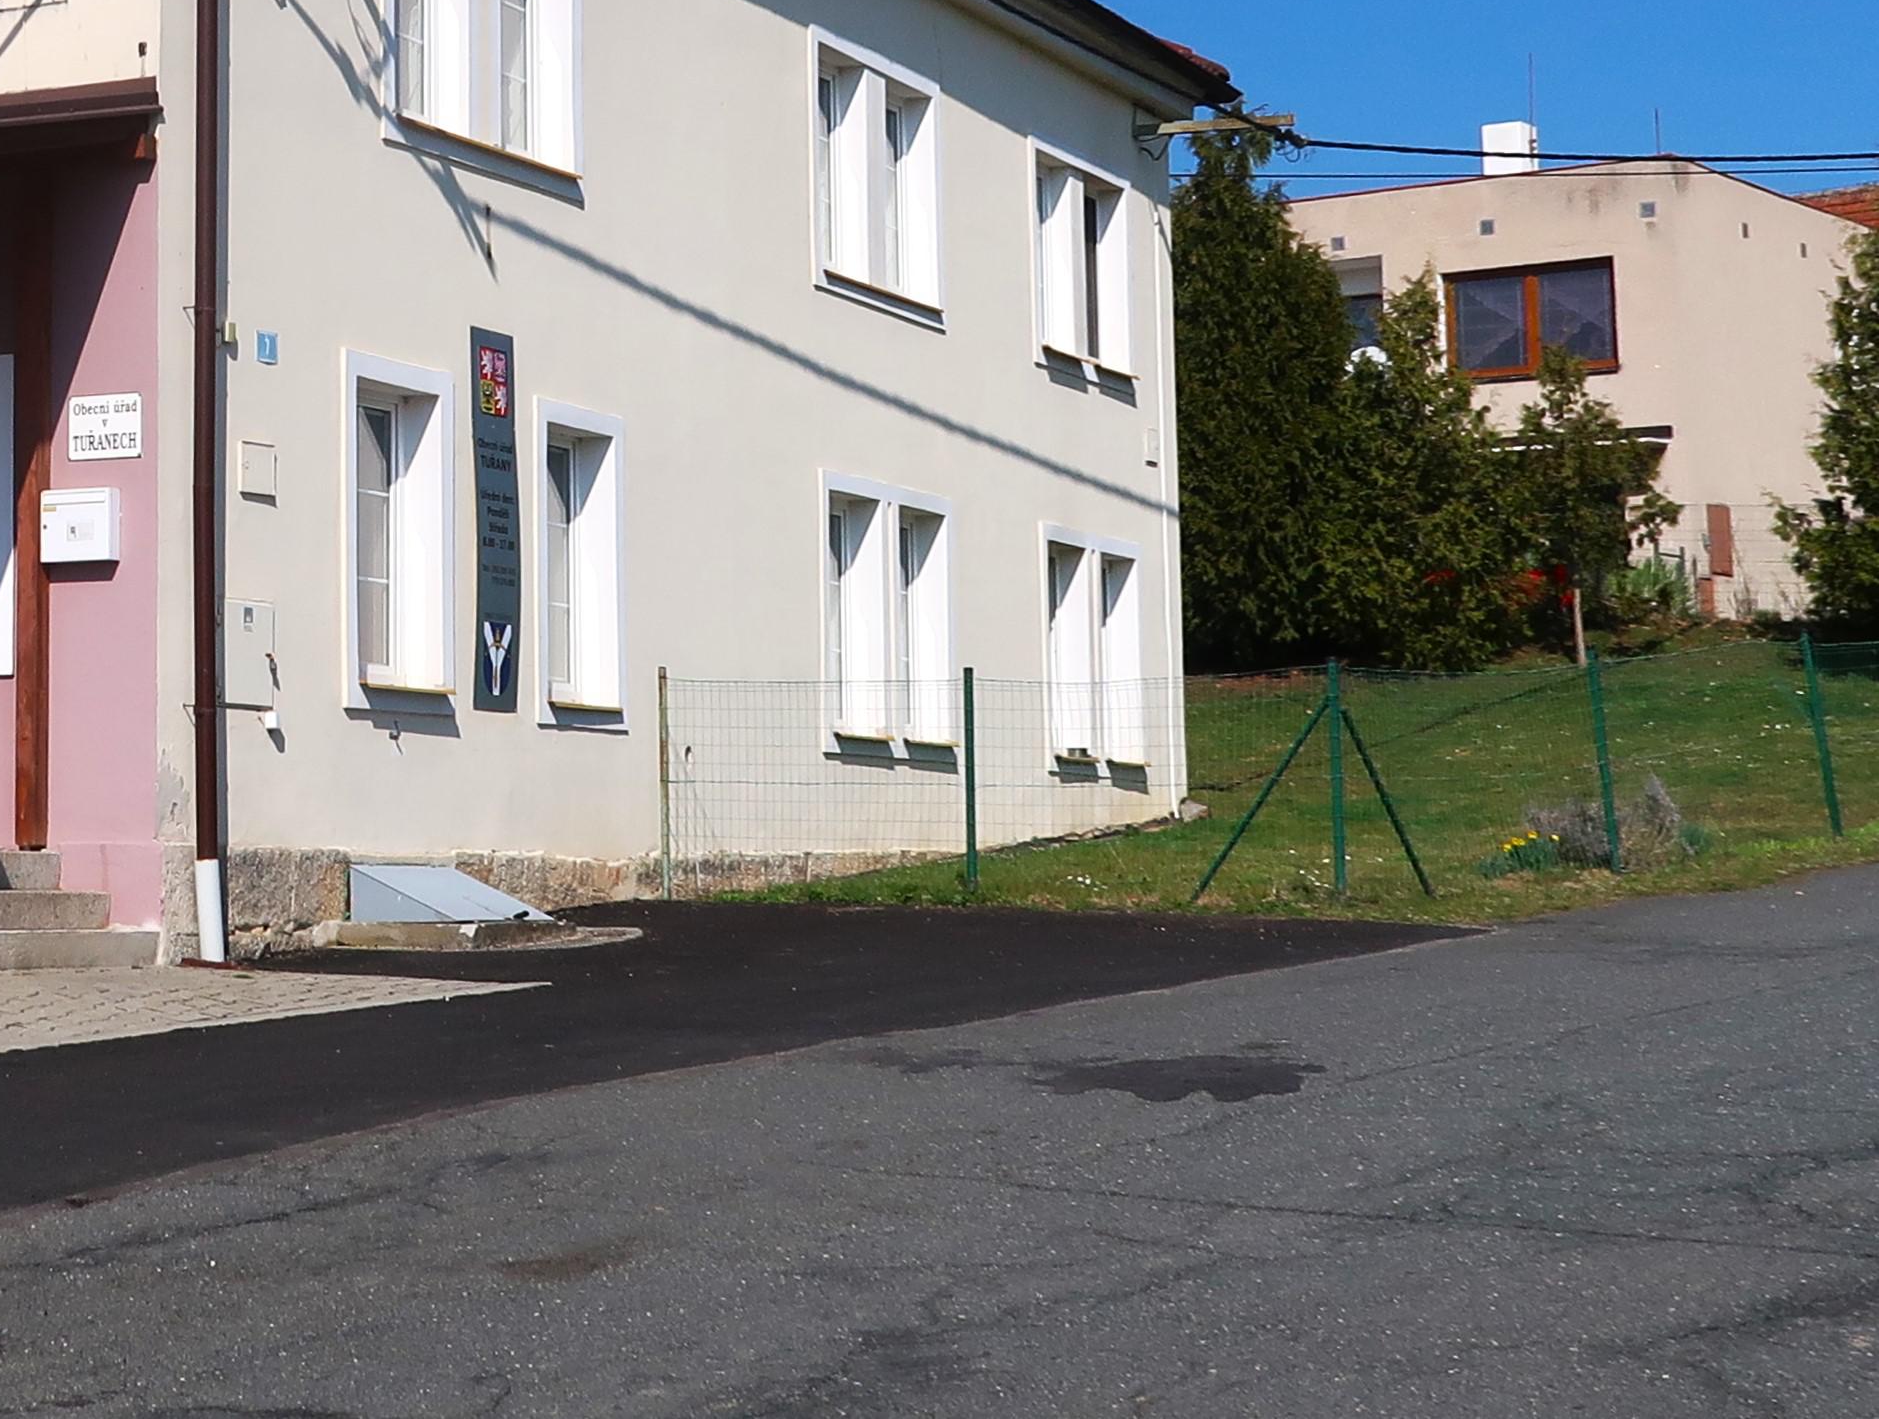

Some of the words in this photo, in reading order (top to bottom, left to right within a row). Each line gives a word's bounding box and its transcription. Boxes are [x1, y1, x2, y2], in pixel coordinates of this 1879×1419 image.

[73, 400, 109, 416] Obecní
[113, 399, 137, 414] úřad
[101, 418, 108, 428] v
[72, 429, 137, 453] TUŘANECH
